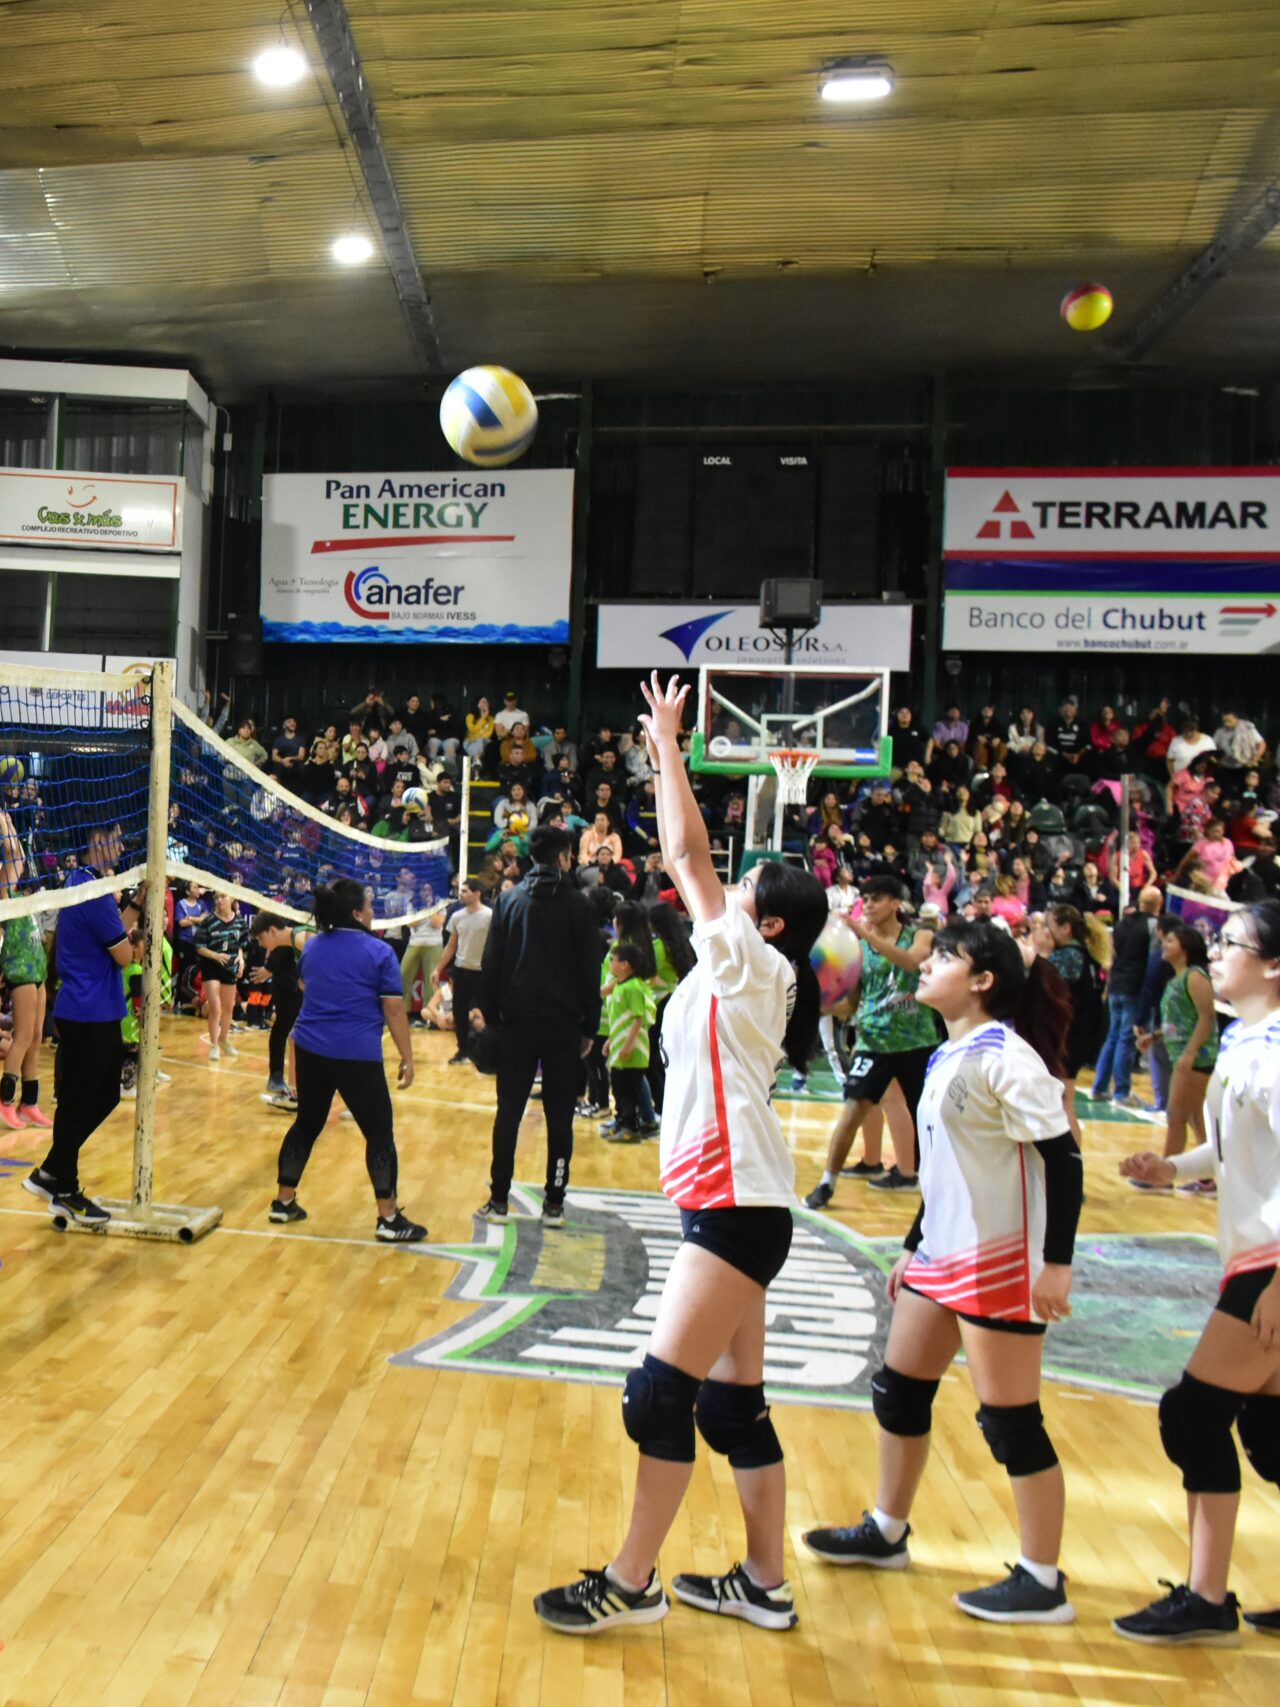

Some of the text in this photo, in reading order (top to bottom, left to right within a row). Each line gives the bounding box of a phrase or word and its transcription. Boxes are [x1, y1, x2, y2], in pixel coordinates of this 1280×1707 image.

[703, 456, 732, 466] LOCAL
[780, 456, 808, 466] VISITA
[324, 477, 506, 499] Pan American
[341, 502, 489, 530] ENERGY
[1031, 501, 1269, 529] TERRAMAR
[21, 525, 138, 537] COMPLEJO RECREATIVO DEPORTIVO
[391, 611, 477, 621] BAJO NORMAS IVESS
[968, 607, 1207, 631] Banco del Chubut
[1056, 638, 1189, 650] www.bancochubut.com.ar
